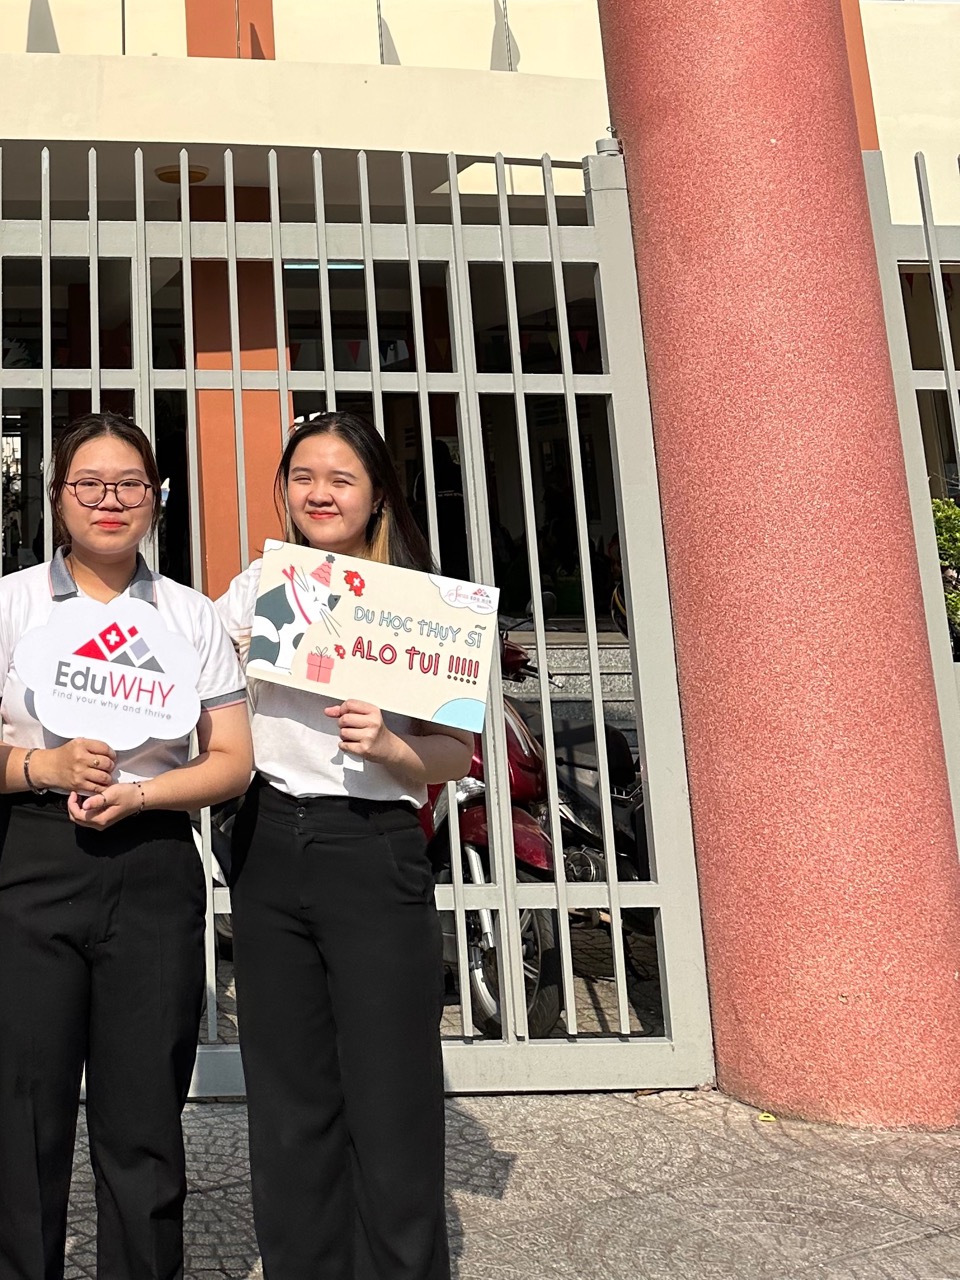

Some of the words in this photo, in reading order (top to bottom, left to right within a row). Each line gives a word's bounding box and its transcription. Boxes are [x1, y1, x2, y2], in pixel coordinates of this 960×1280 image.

[353, 605, 375, 624] DU
[378, 610, 413, 637] HỌC
[417, 619, 462, 647] THỤY
[464, 624, 487, 648] SĨ
[351, 636, 398, 665] ALO
[405, 646, 441, 676] TUI
[52, 688, 73, 701] Find
[75, 694, 97, 705] your
[100, 699, 119, 712] why
[122, 703, 141, 714] and
[144, 707, 173, 721] thrive
[54, 660, 176, 708] EduWHY
